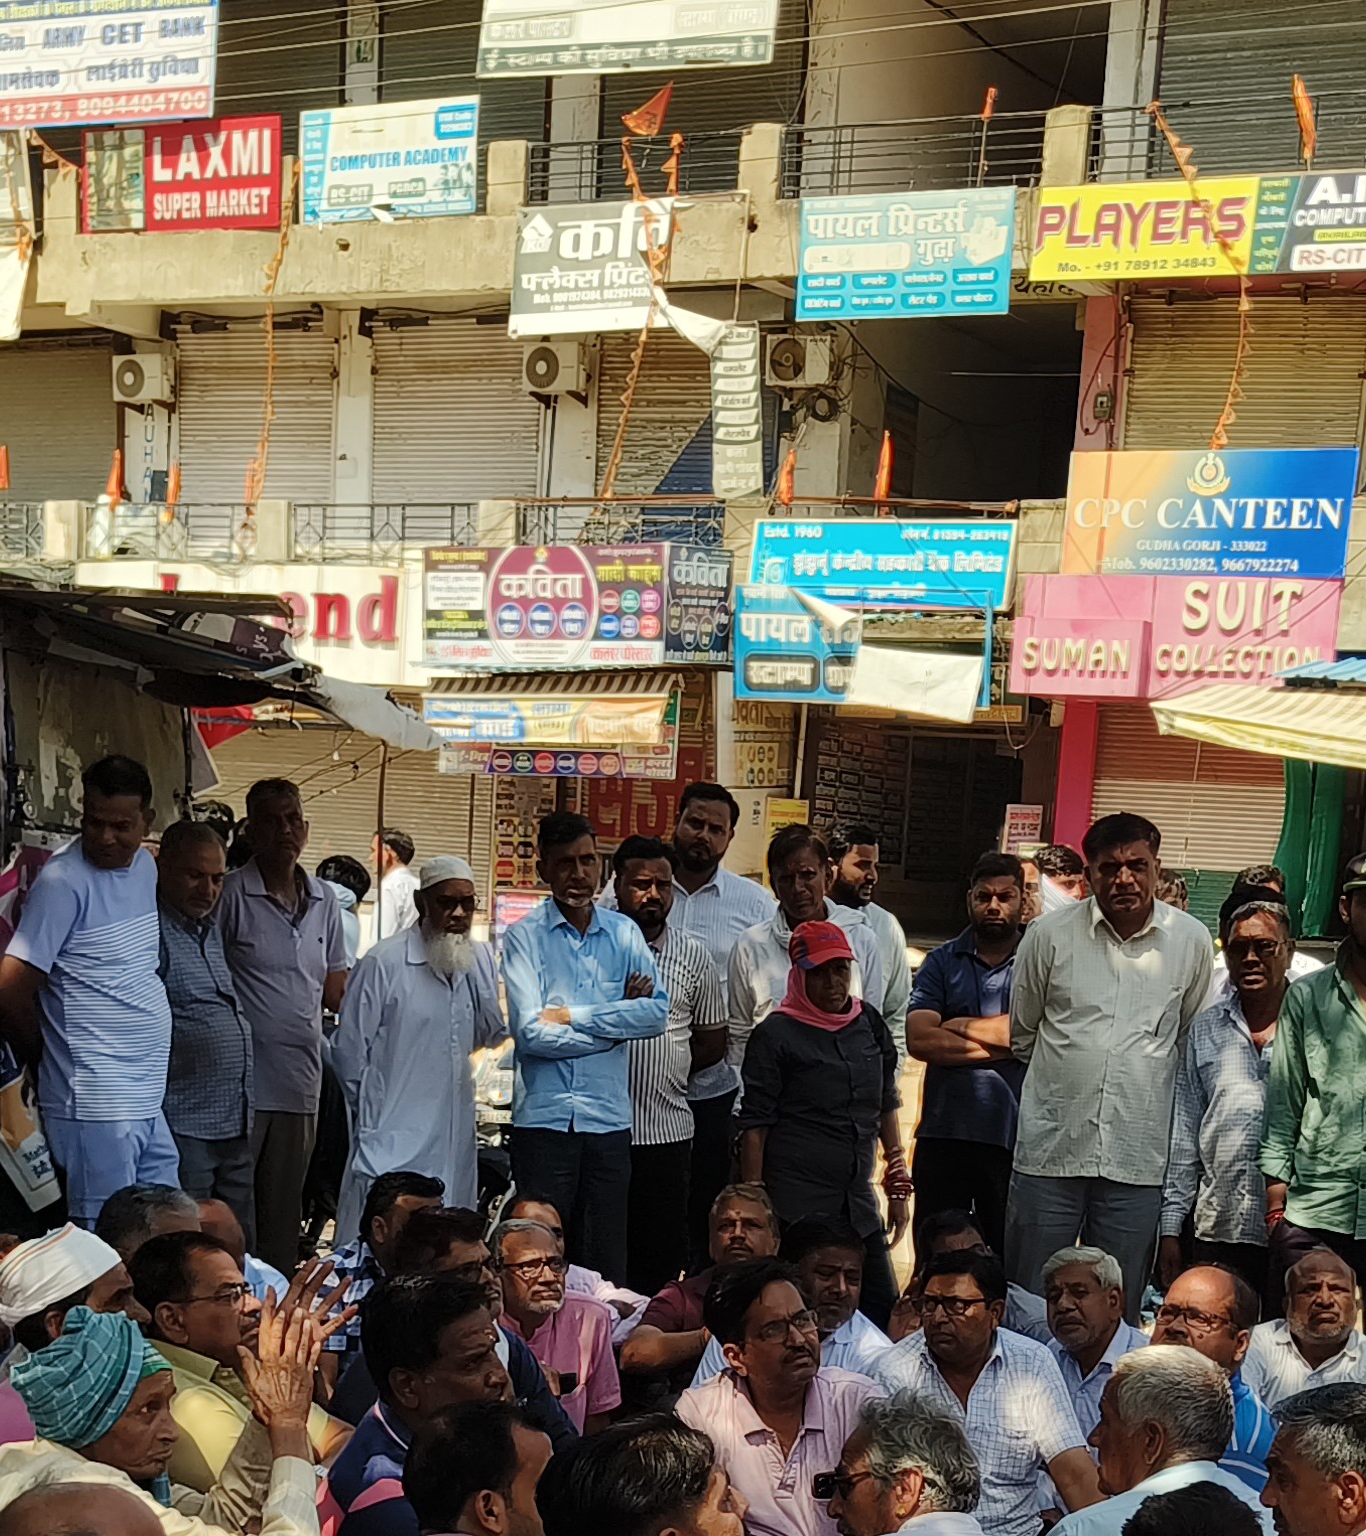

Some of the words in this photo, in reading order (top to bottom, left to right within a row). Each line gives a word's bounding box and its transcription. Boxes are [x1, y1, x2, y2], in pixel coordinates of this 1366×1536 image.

[42, 24, 87, 50] ARMY
[100, 21, 146, 46] CET
[158, 16, 206, 39] BANK
[152, 128, 272, 182] LAXMI
[330, 150, 402, 173] COMPUTER
[404, 145, 469, 167] ACADEMY
[153, 189, 202, 221] SUPER
[205, 186, 272, 218] MARKET
[806, 211, 883, 240] पायल
[887, 199, 968, 237] प्रिन्टर्स
[1034, 196, 1253, 256] PLAYERS
[1057, 261, 1082, 273] Mo.
[1094, 260, 1120, 272] +91
[1297, 246, 1366, 266] RS-CIT
[1073, 497, 1148, 530] CPC
[1155, 496, 1346, 531] CANTEEN
[763, 525, 790, 539] Estd.
[793, 525, 823, 539] 1960
[1136, 539, 1181, 553] GUDHA
[673, 551, 730, 588] कविता
[1139, 556, 1218, 574] 9602330282,
[1221, 558, 1299, 573] 9667922274
[498, 564, 584, 599] कविता
[1182, 580, 1303, 637] SUIT
[740, 612, 815, 643] पायल
[1024, 637, 1131, 680] SUMAN
[1154, 643, 1321, 680] COLLECTION
